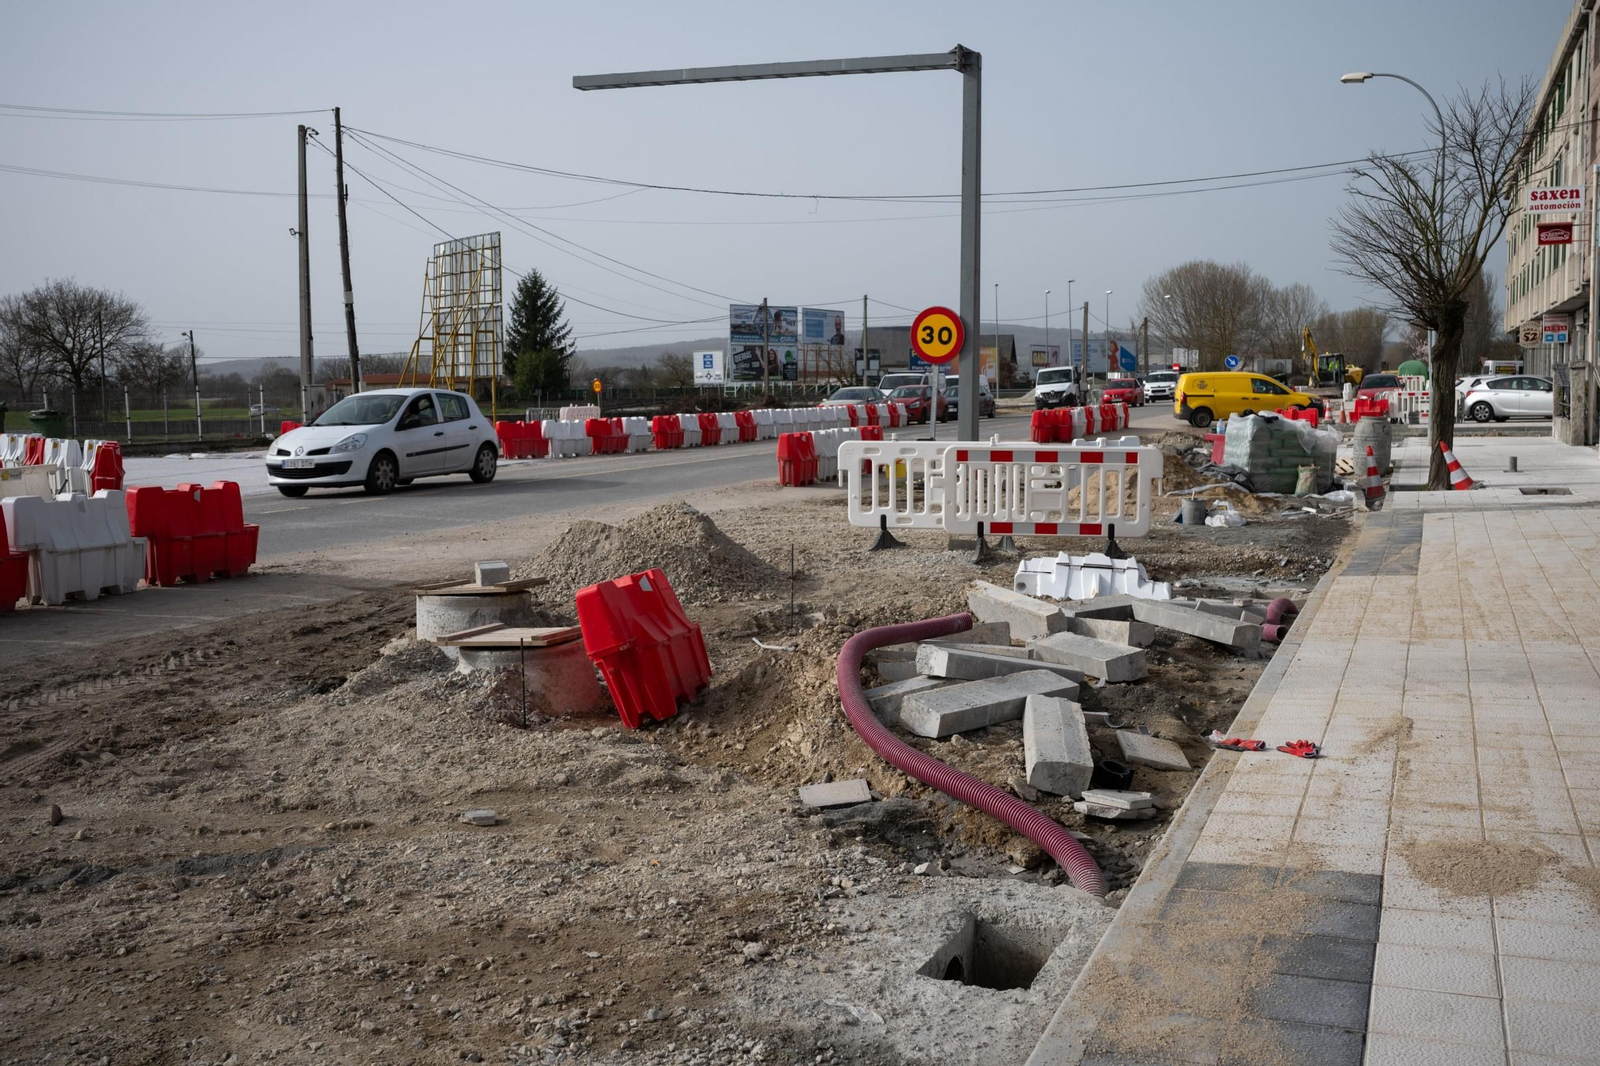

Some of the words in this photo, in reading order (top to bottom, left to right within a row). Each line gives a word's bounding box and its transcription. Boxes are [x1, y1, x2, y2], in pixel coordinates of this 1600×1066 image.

[1530, 188, 1581, 201] saxen
[1529, 201, 1581, 211] automoción
[921, 325, 953, 345] 30
[1523, 332, 1538, 343] 52
